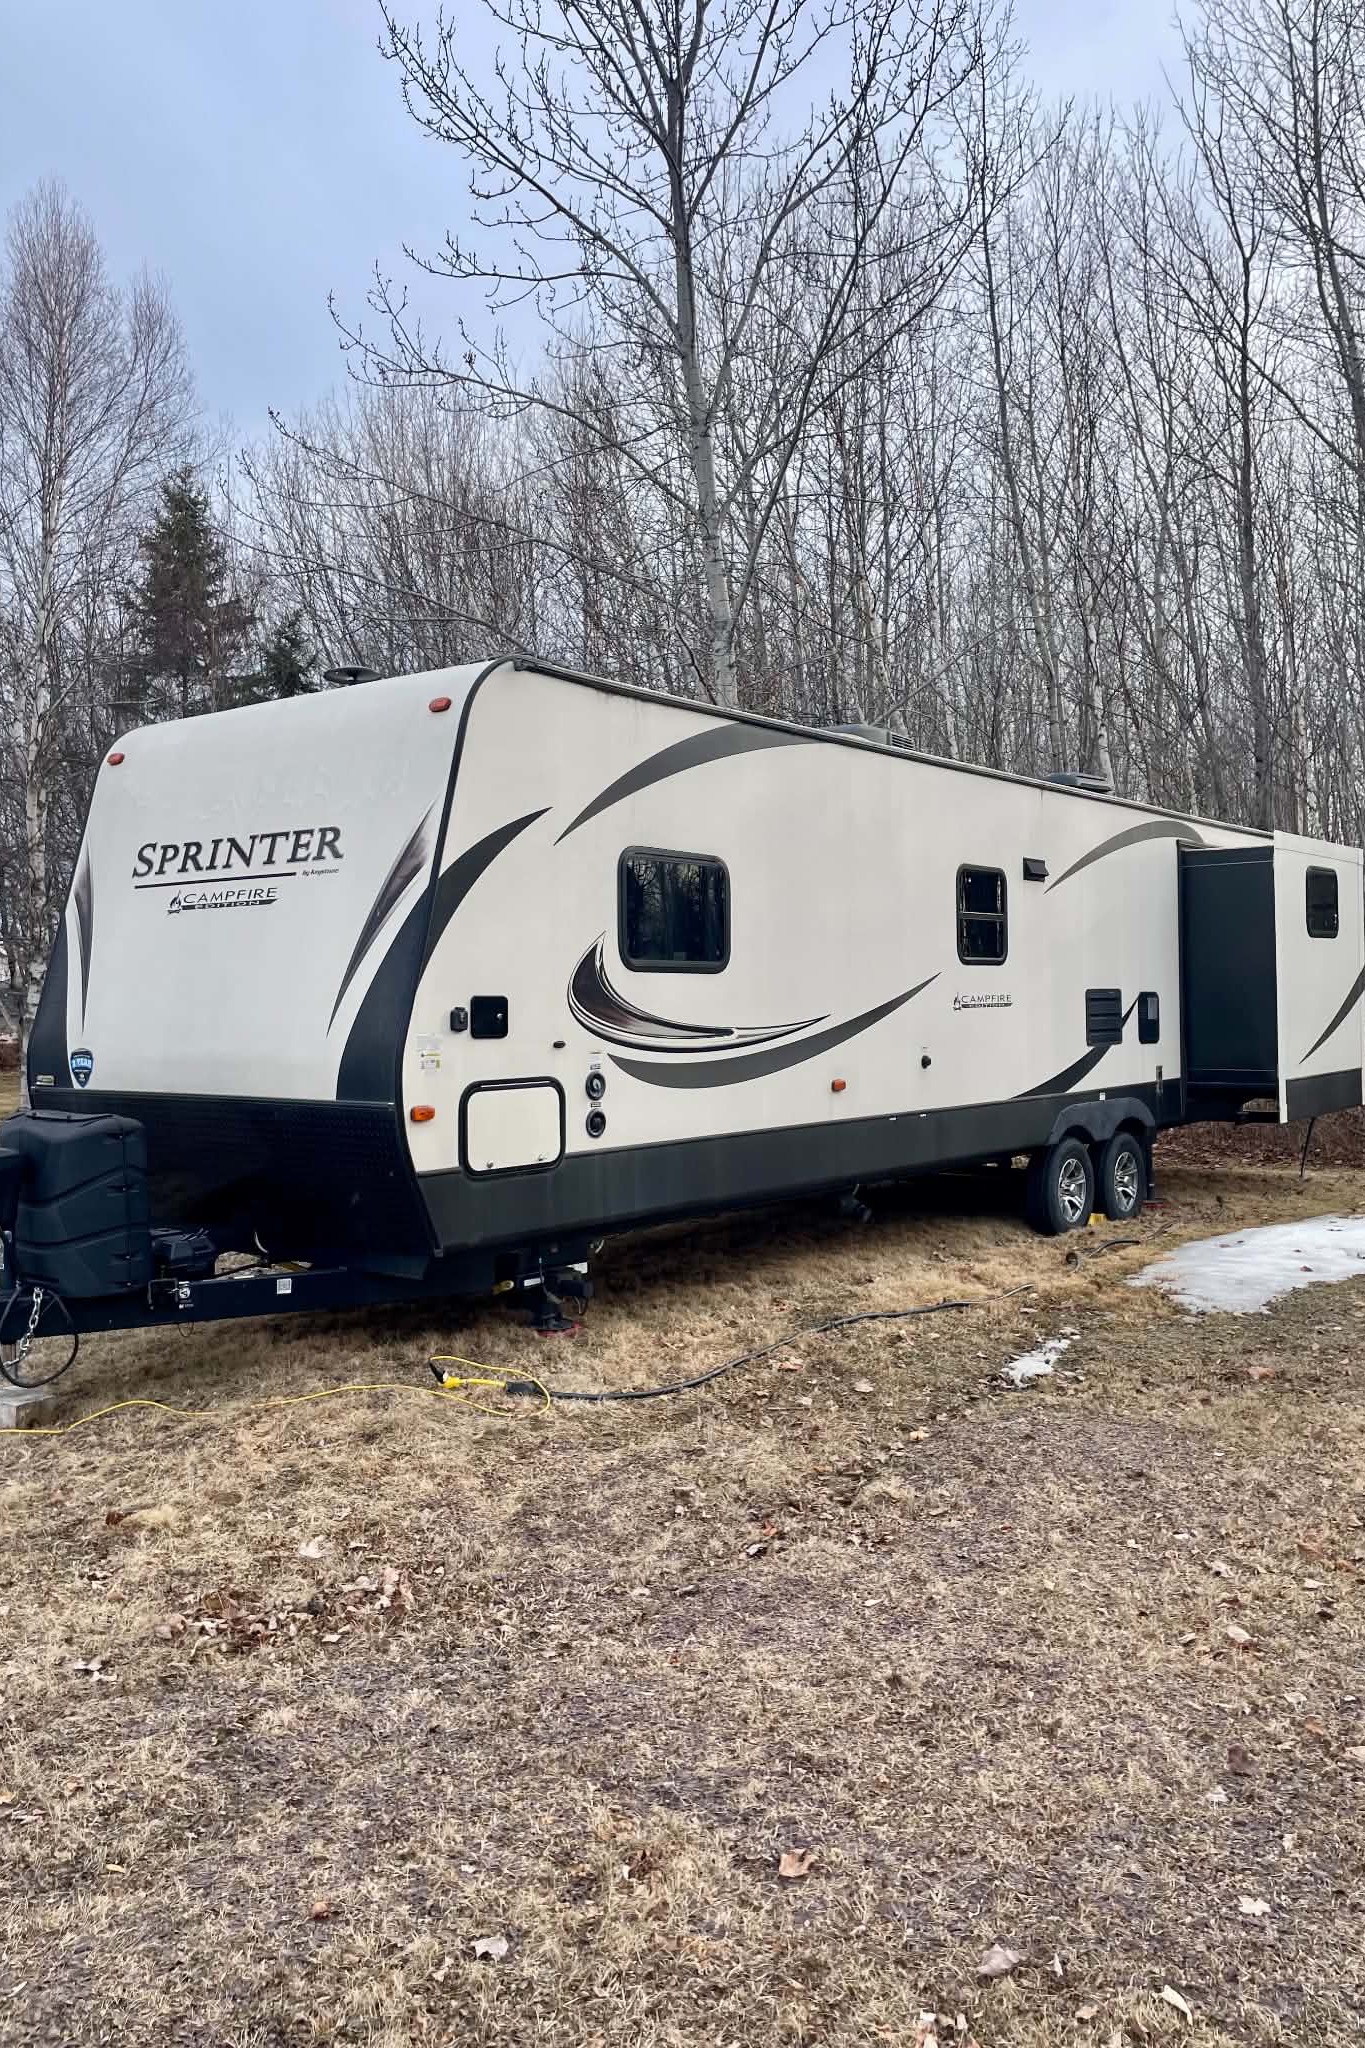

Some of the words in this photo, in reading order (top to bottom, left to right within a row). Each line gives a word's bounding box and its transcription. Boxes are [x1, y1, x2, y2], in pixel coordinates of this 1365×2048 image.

[132, 826, 344, 878] SPRINTER
[183, 887, 278, 904] CAMPFIRE
[194, 900, 261, 910] EDITION
[961, 994, 1012, 1004] CAMPFIRE
